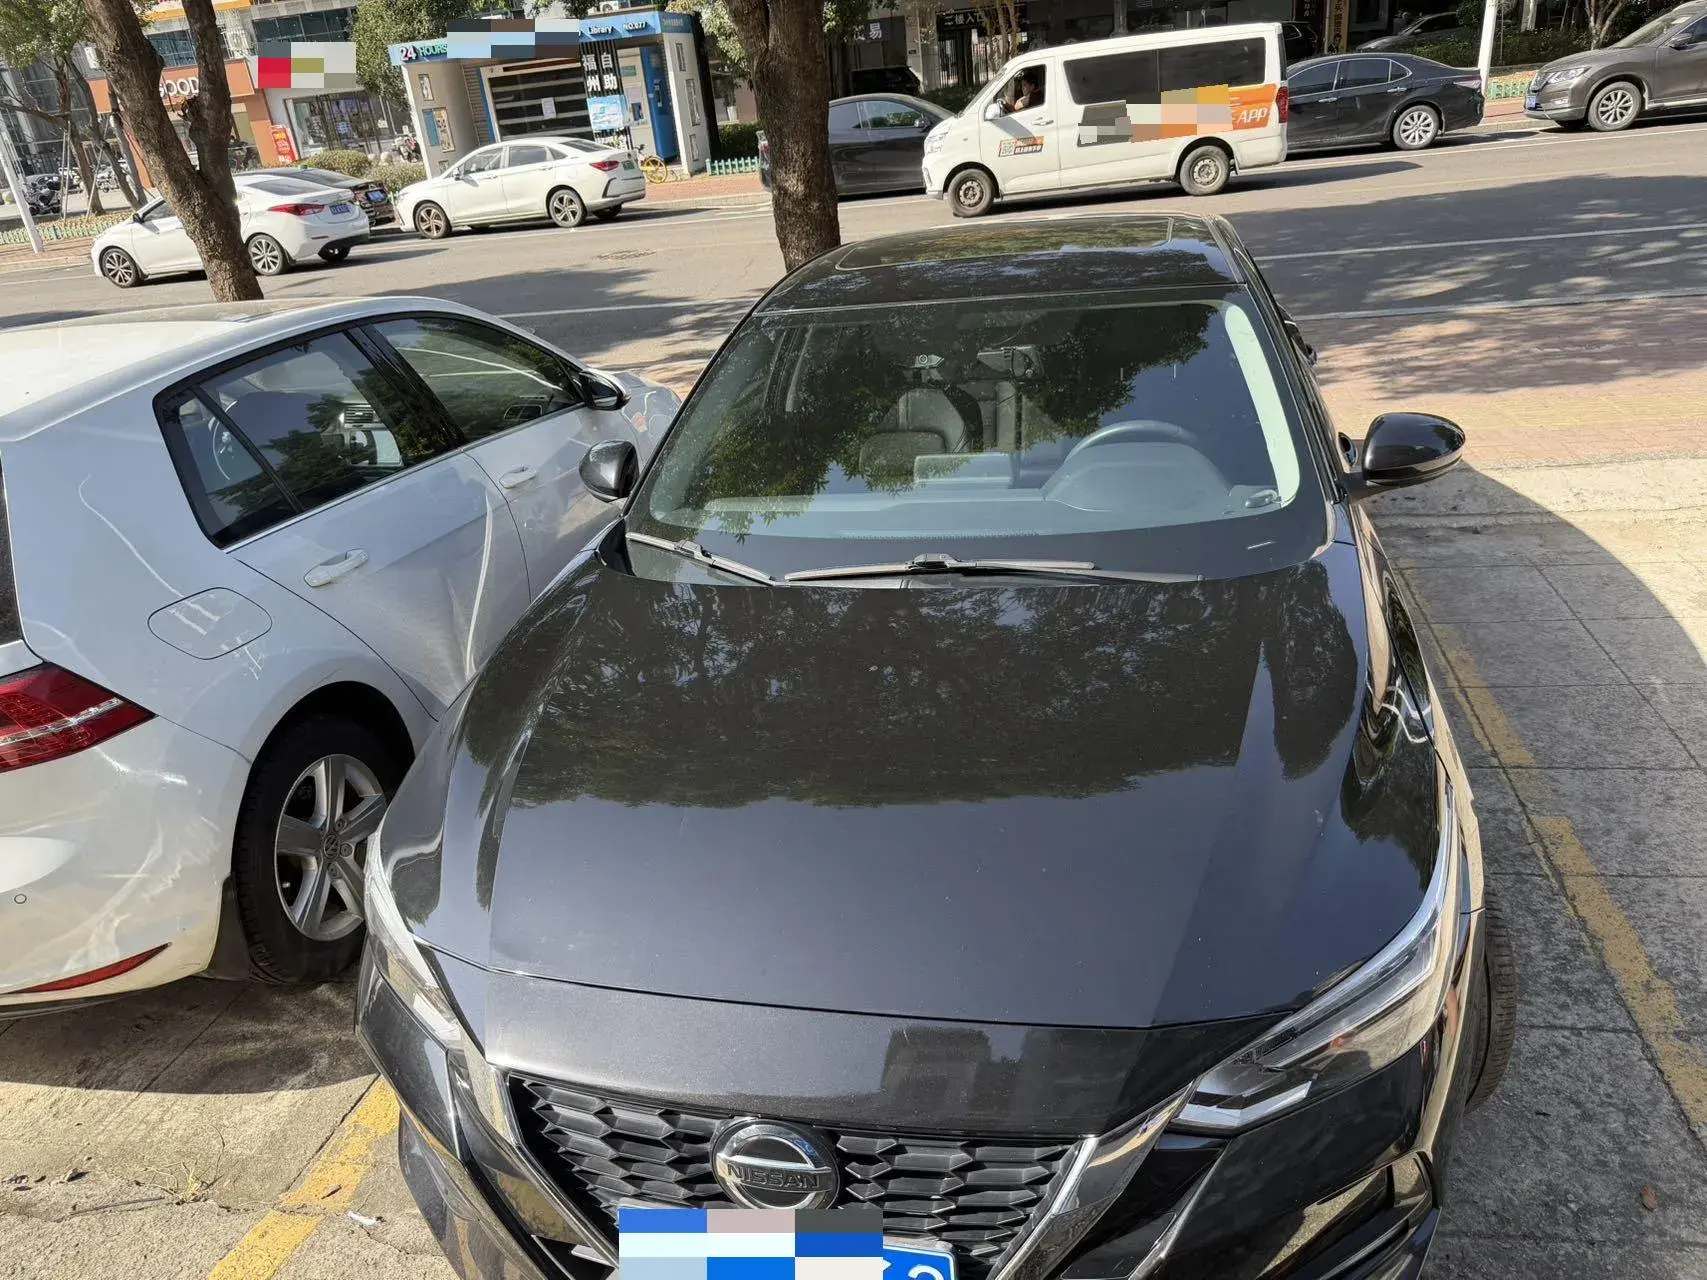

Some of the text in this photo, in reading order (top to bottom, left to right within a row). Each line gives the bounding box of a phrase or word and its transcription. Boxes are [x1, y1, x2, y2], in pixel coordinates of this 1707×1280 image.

[587, 25, 613, 35] Library
[400, 45, 417, 61] 24
[1237, 107, 1268, 123] APP
[728, 1163, 821, 1189] NISSAN
